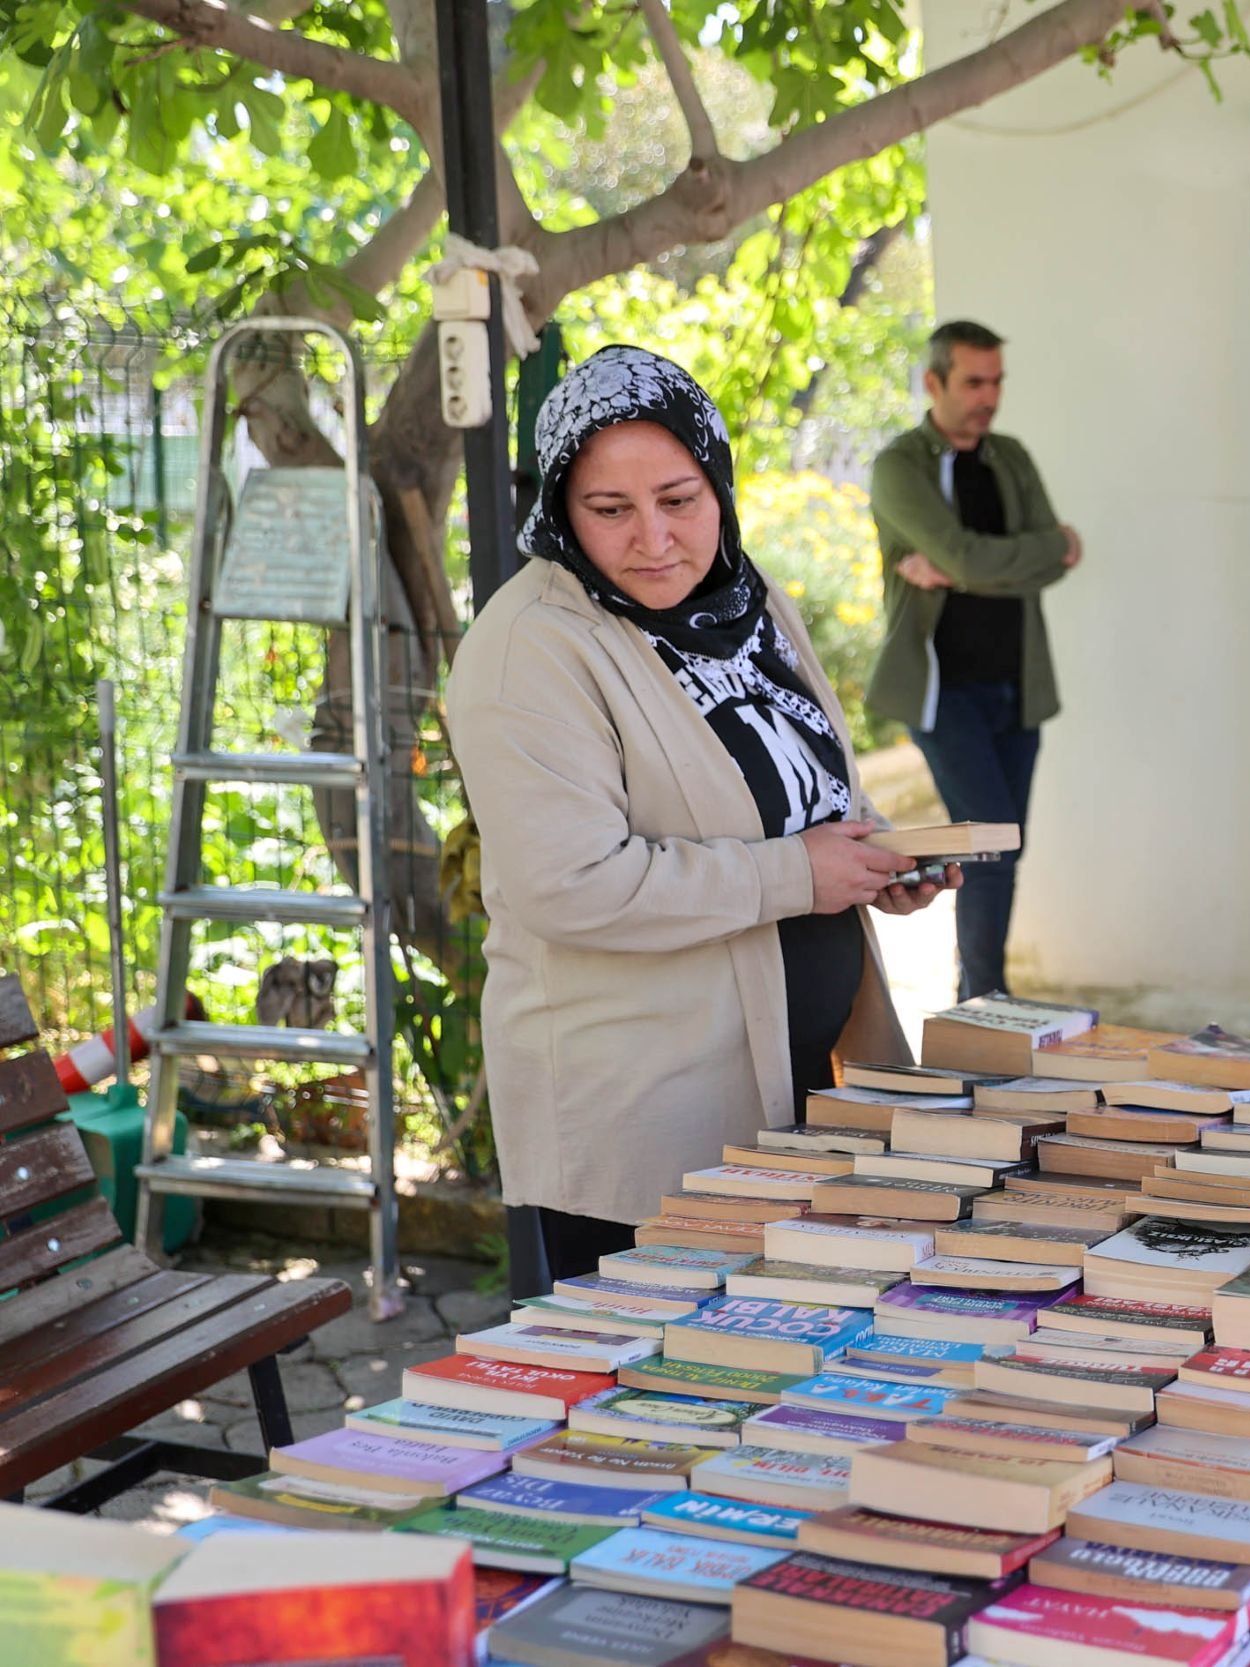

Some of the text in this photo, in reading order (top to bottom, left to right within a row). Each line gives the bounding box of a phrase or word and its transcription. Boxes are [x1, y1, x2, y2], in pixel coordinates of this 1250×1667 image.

[589, 1302, 654, 1315] Heidi
[864, 1342, 948, 1358] MARTI
[528, 1368, 577, 1382] OKUL
[409, 1402, 527, 1423] COPPERFIELD
[429, 1411, 486, 1425] DAVID
[473, 1487, 565, 1510] Beyaz
[673, 1500, 801, 1532] ERMİN
